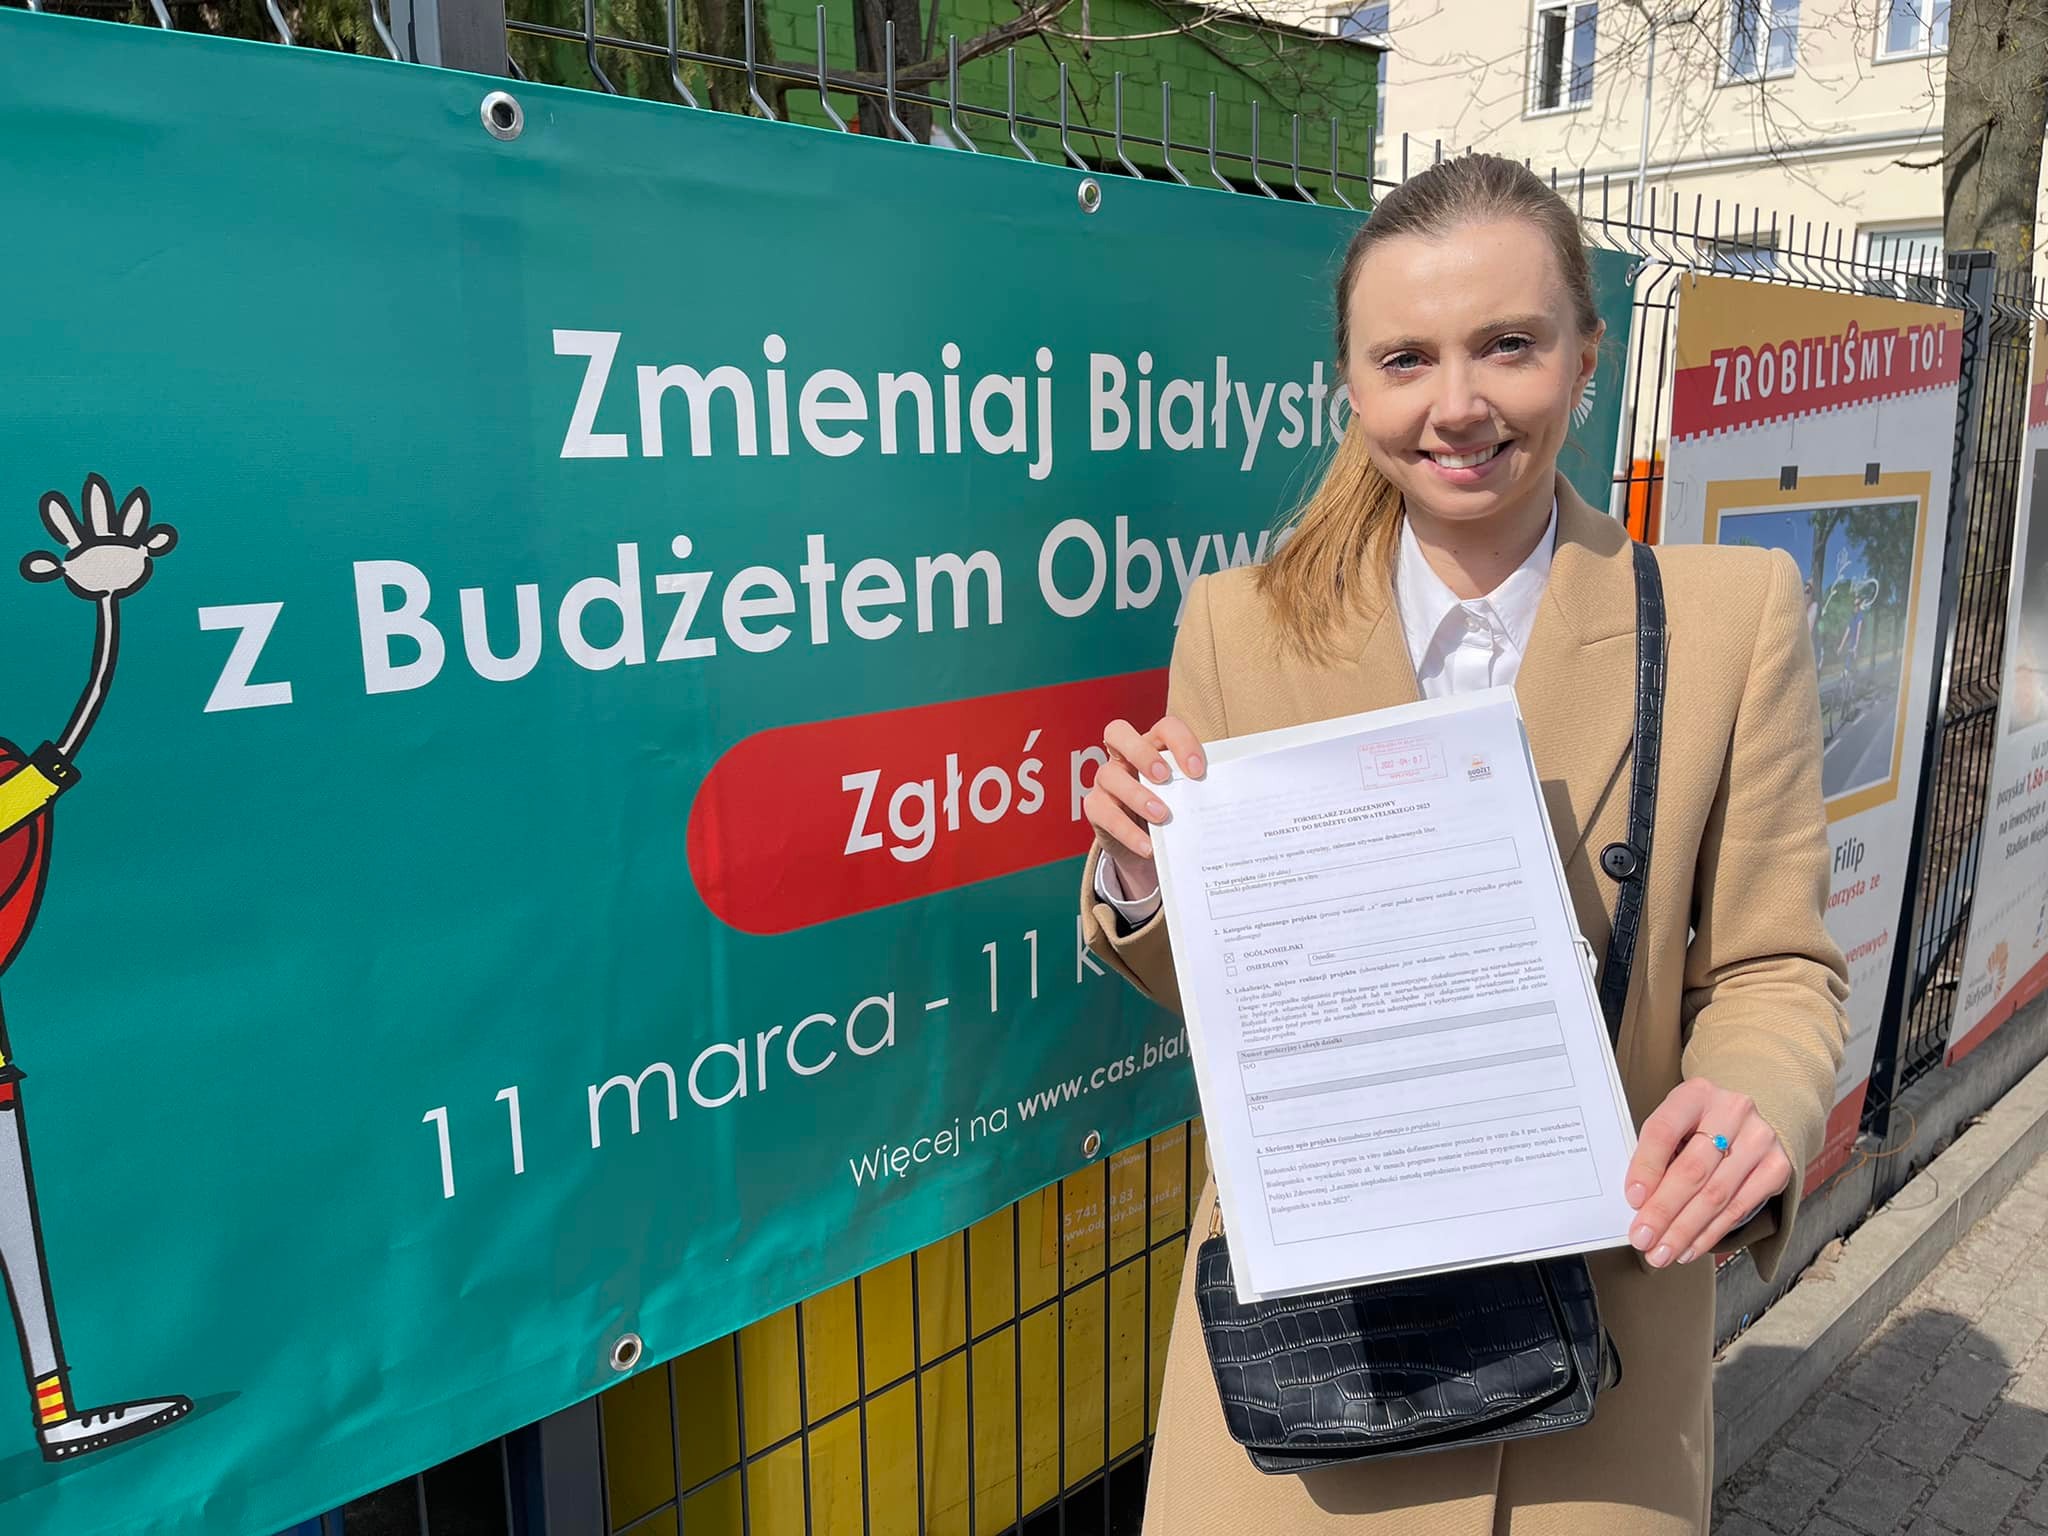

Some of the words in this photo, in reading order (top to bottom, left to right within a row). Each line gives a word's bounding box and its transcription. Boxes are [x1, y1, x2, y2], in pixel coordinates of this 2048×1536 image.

[552, 328, 1053, 481] Zmieniaj
[1713, 328, 1896, 406] ZROBILIŚMY
[1909, 329, 1944, 373] TO!
[198, 602, 293, 713] z
[353, 534, 1003, 695] Budżetem
[1038, 515, 1270, 627] Obyw
[842, 729, 1045, 862] Zgłoś
[1263, 825, 1300, 837] PROJEKTU
[1313, 817, 1346, 828] BUDŻETU
[1347, 805, 1415, 822] OBYWATELSKIEGO
[1292, 810, 1338, 823] FORMULARZ
[1338, 800, 1395, 815] ZGŁOSZENIOWY
[1833, 837, 1865, 873] Filip
[1242, 941, 1303, 958] OGÓLNOMIEJSKI
[1245, 959, 1289, 971] OSIEDLOWY
[422, 1066, 524, 1199] 11
[587, 991, 896, 1149] marca
[982, 929, 1038, 1012] 11
[849, 1117, 960, 1188] Więcej
[969, 1106, 1009, 1143] na
